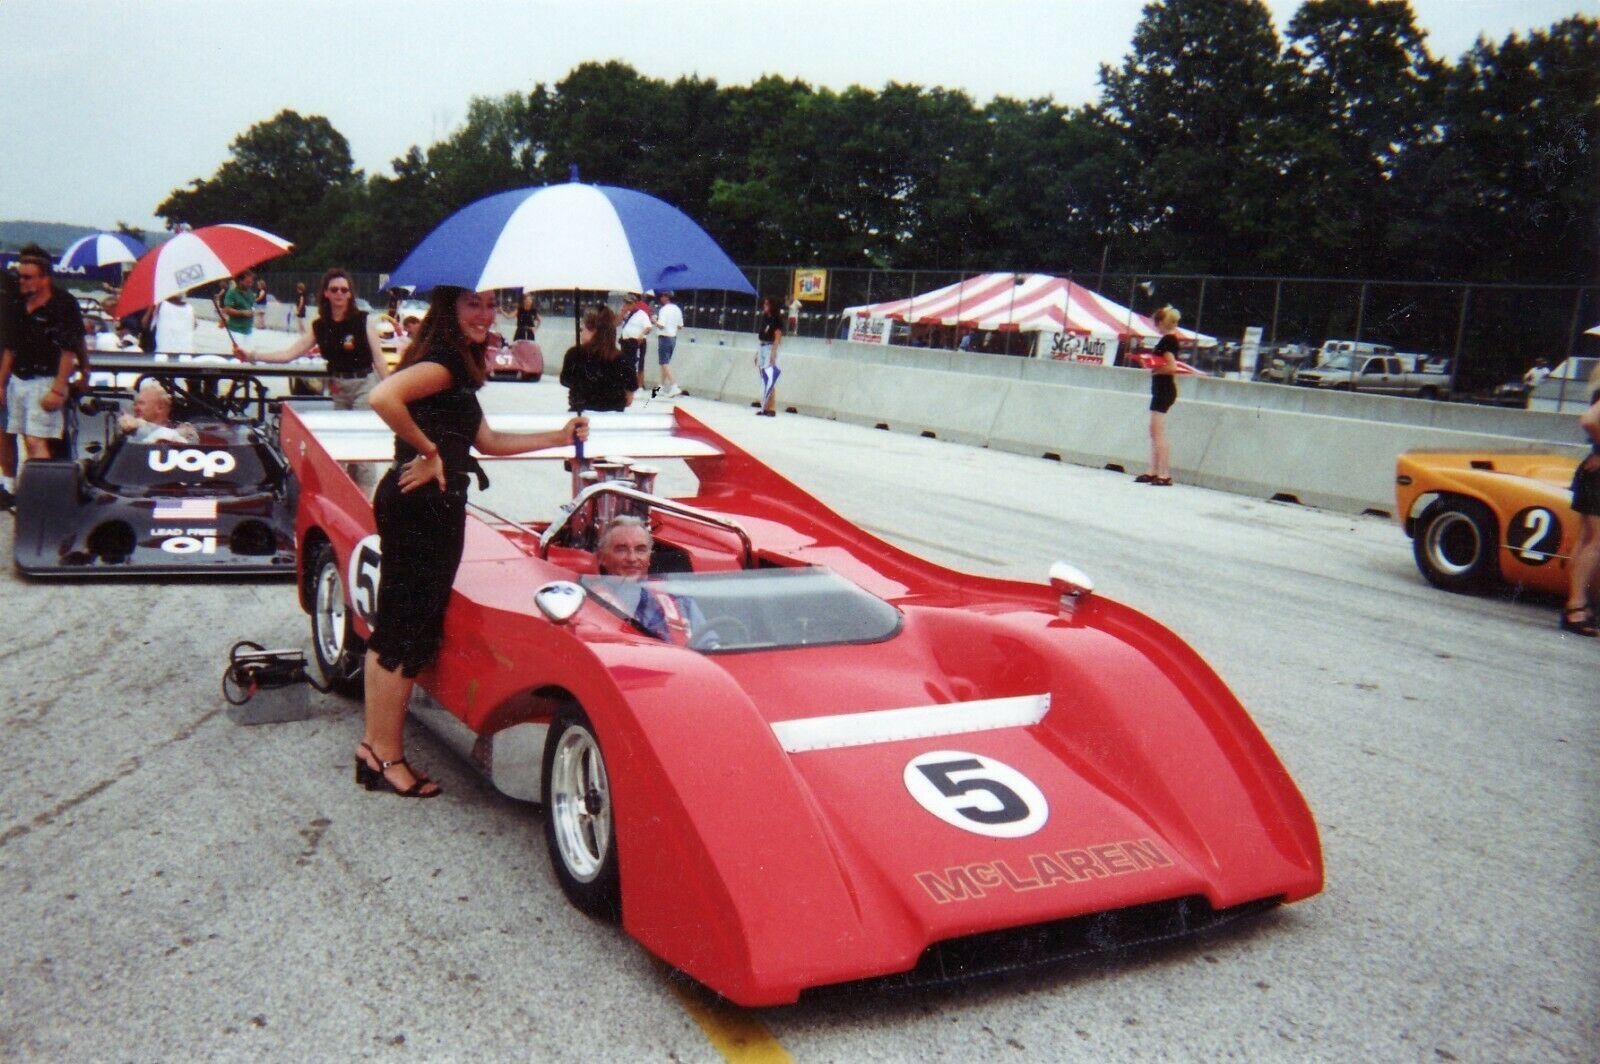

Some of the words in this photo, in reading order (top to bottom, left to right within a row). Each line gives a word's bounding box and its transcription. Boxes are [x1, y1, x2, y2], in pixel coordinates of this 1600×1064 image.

[150, 528, 183, 537] LEAD
[1520, 508, 1550, 561] 2
[356, 545, 382, 627] 5
[916, 758, 1030, 825] 5
